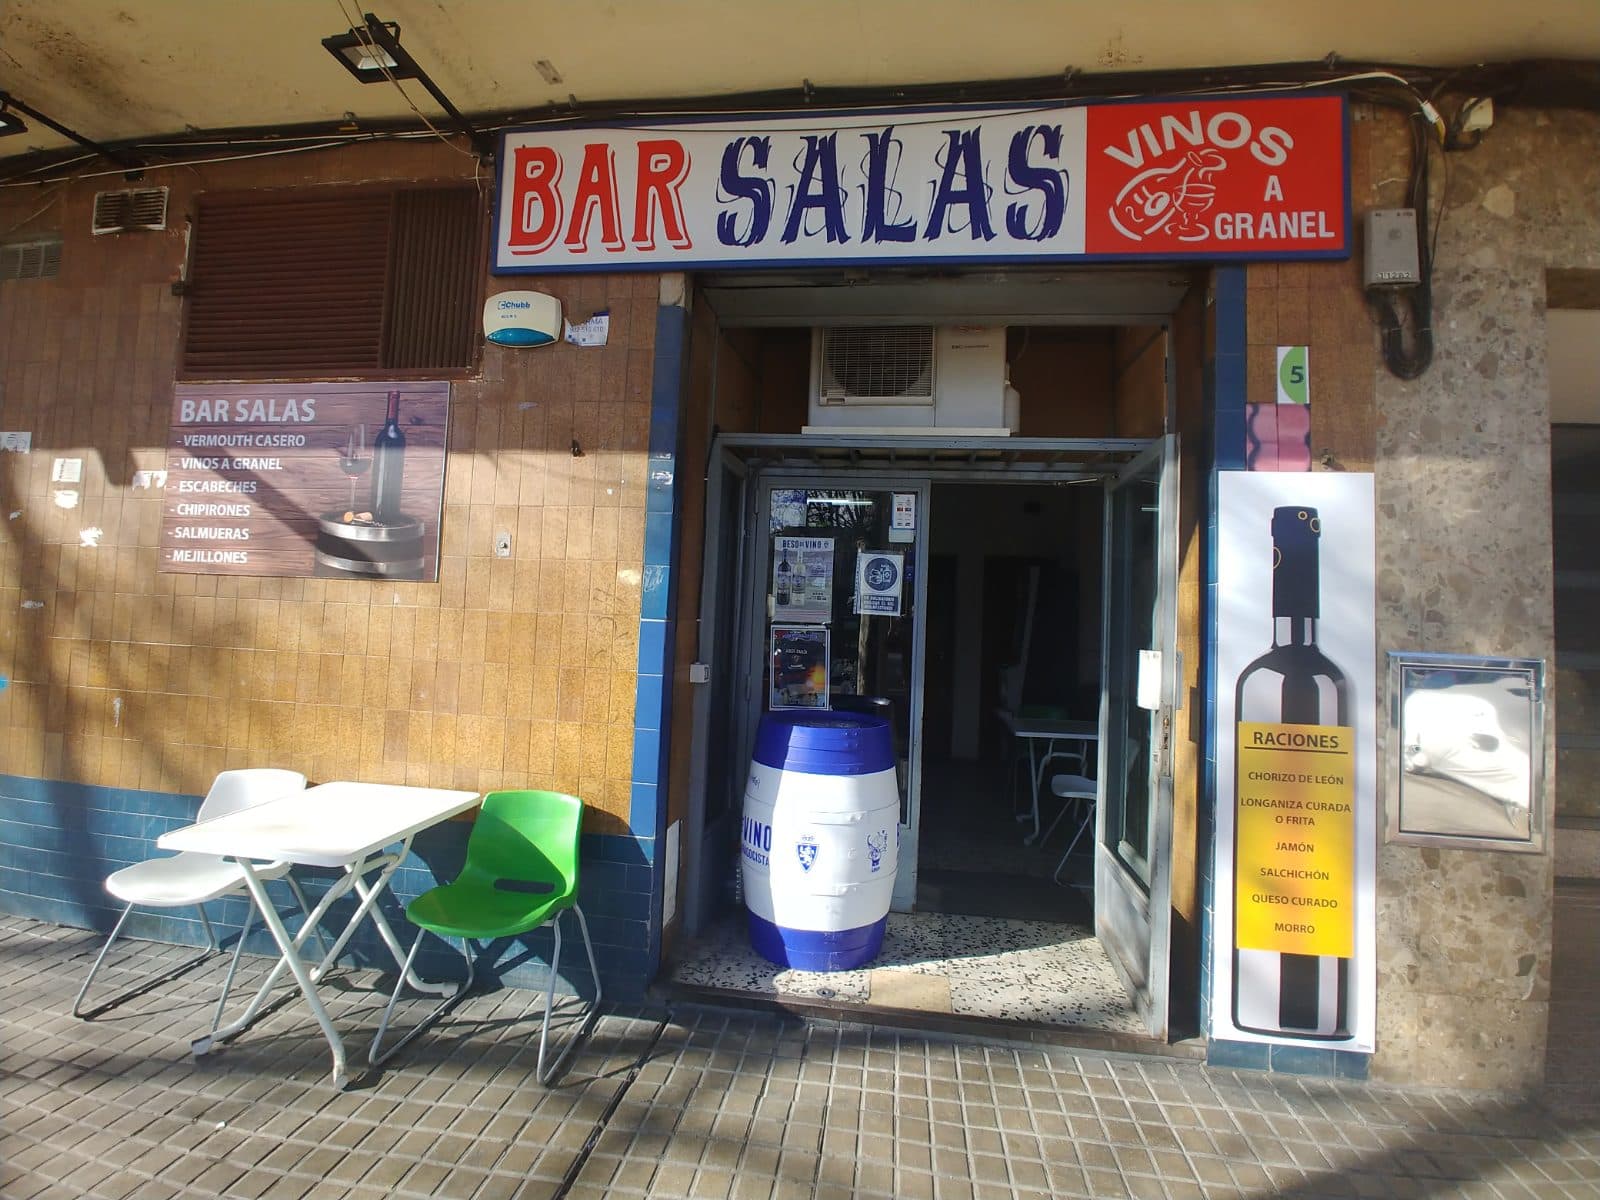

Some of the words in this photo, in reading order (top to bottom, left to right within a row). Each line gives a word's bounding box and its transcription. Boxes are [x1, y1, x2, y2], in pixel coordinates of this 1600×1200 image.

[1104, 111, 1294, 168] VINOS
[508, 139, 692, 255] BAR
[716, 125, 1068, 248] SALAS
[1264, 175, 1284, 202] A
[1214, 211, 1335, 241] GRANEL
[506, 301, 530, 309] Chubb
[1290, 366, 1304, 384] 5
[180, 399, 228, 423] BAR
[234, 398, 316, 422] SALAS
[255, 434, 306, 448] CASERO
[221, 458, 230, 470] A
[233, 458, 283, 471] GRANEL
[1253, 731, 1339, 749] RACIONES
[1248, 771, 1296, 783] CHORIZO
[1299, 774, 1313, 784] DE
[1315, 773, 1344, 785] LEÓN
[1240, 797, 1303, 810] LONGANIZA
[1306, 801, 1351, 813] CURADA
[1275, 815, 1284, 824] O
[1286, 816, 1315, 826] FRITA
[743, 815, 772, 852] VINO
[1275, 840, 1314, 853] JAMÓN
[1260, 866, 1330, 881] SALCHICHÓN
[1251, 894, 1289, 905] QUESO
[1291, 897, 1338, 909] CURADO
[1274, 922, 1315, 934] MORRO
